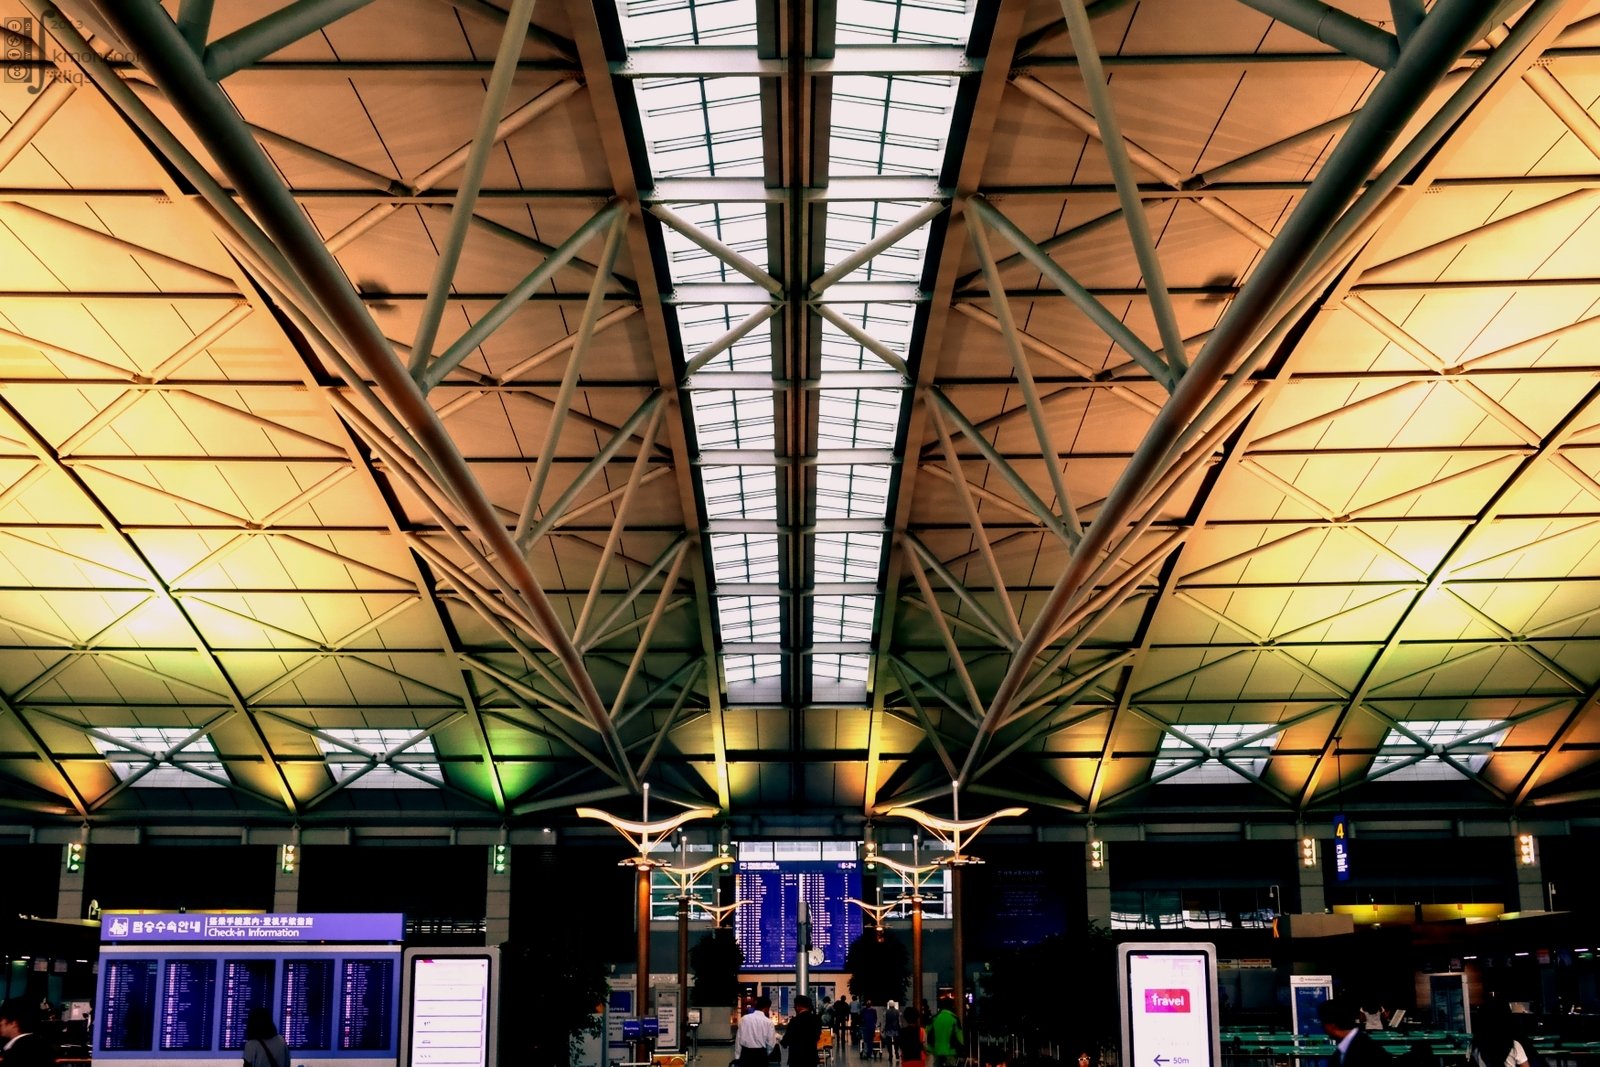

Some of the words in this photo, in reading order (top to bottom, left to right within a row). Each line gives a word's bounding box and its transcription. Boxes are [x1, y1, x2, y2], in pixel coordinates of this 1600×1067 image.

[1336, 823, 1344, 839] 4
[208, 928, 245, 937] Check-in
[248, 928, 299, 937] Information
[1151, 993, 1185, 1006] travel
